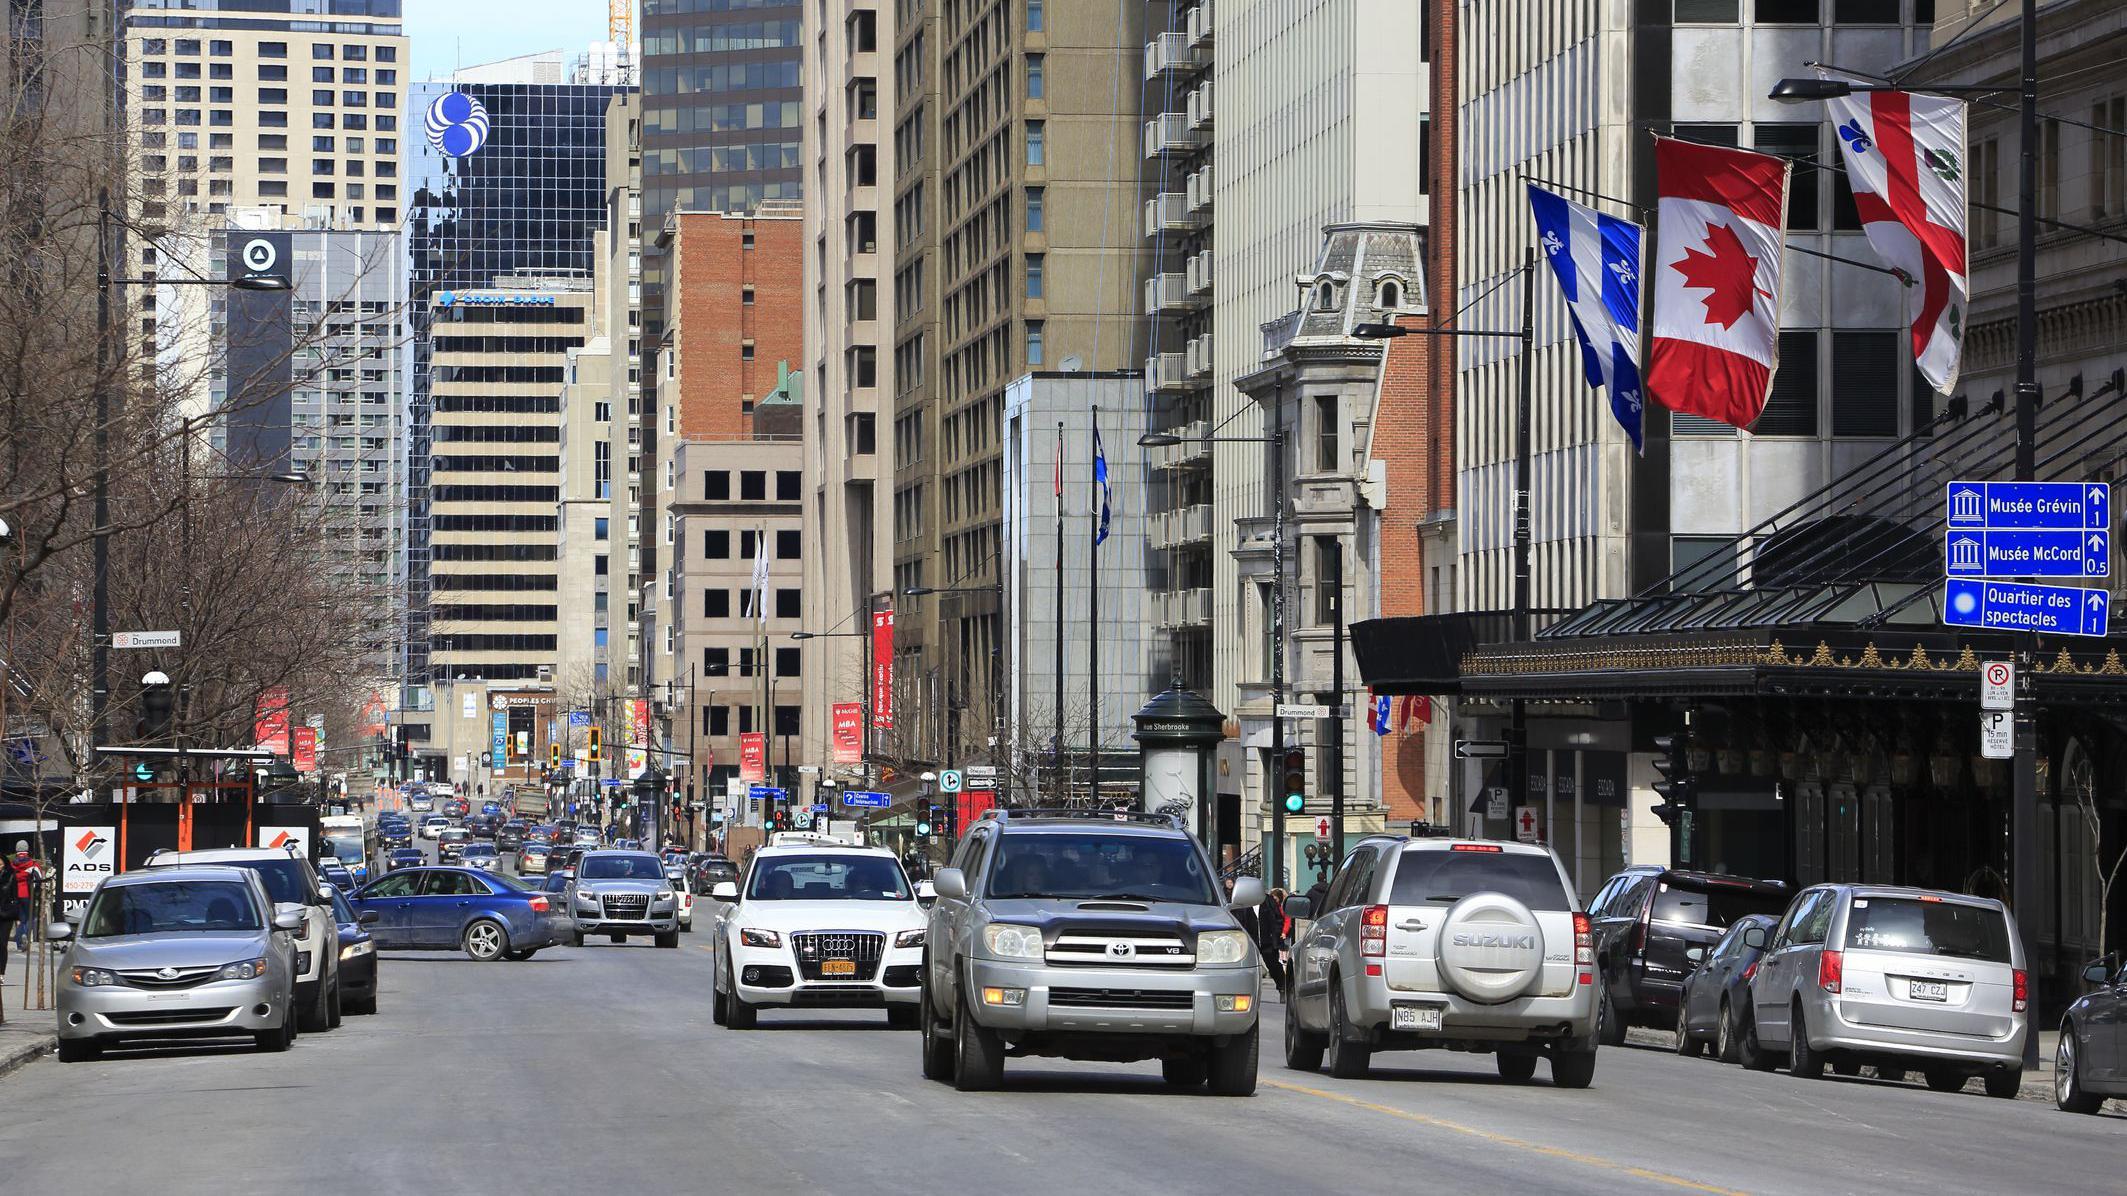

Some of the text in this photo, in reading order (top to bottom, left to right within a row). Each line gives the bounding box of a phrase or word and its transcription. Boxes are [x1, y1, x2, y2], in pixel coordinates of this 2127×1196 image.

[1990, 499, 2081, 514] Musée Grévin
[2094, 511, 2100, 526] 1
[1989, 546, 2081, 561] Musée McCord
[2086, 559, 2106, 574] 0,5
[1988, 588, 2071, 608] Quartier des
[1986, 610, 2058, 627] spectacles
[2092, 617, 2097, 633] 1
[132, 636, 177, 646] Drummond
[1280, 708, 1315, 716] Drummond
[838, 720, 856, 728] MBA
[1153, 723, 1189, 731] Sherbrooke
[1992, 713, 2004, 729] P
[1494, 789, 1503, 800] P
[1598, 779, 1616, 796] ESCADA
[68, 863, 111, 872] ADS
[1453, 933, 1535, 950] SUZUKI
[1931, 986, 1945, 996] CZJ
[1398, 1010, 1438, 1023] N85 AJH
